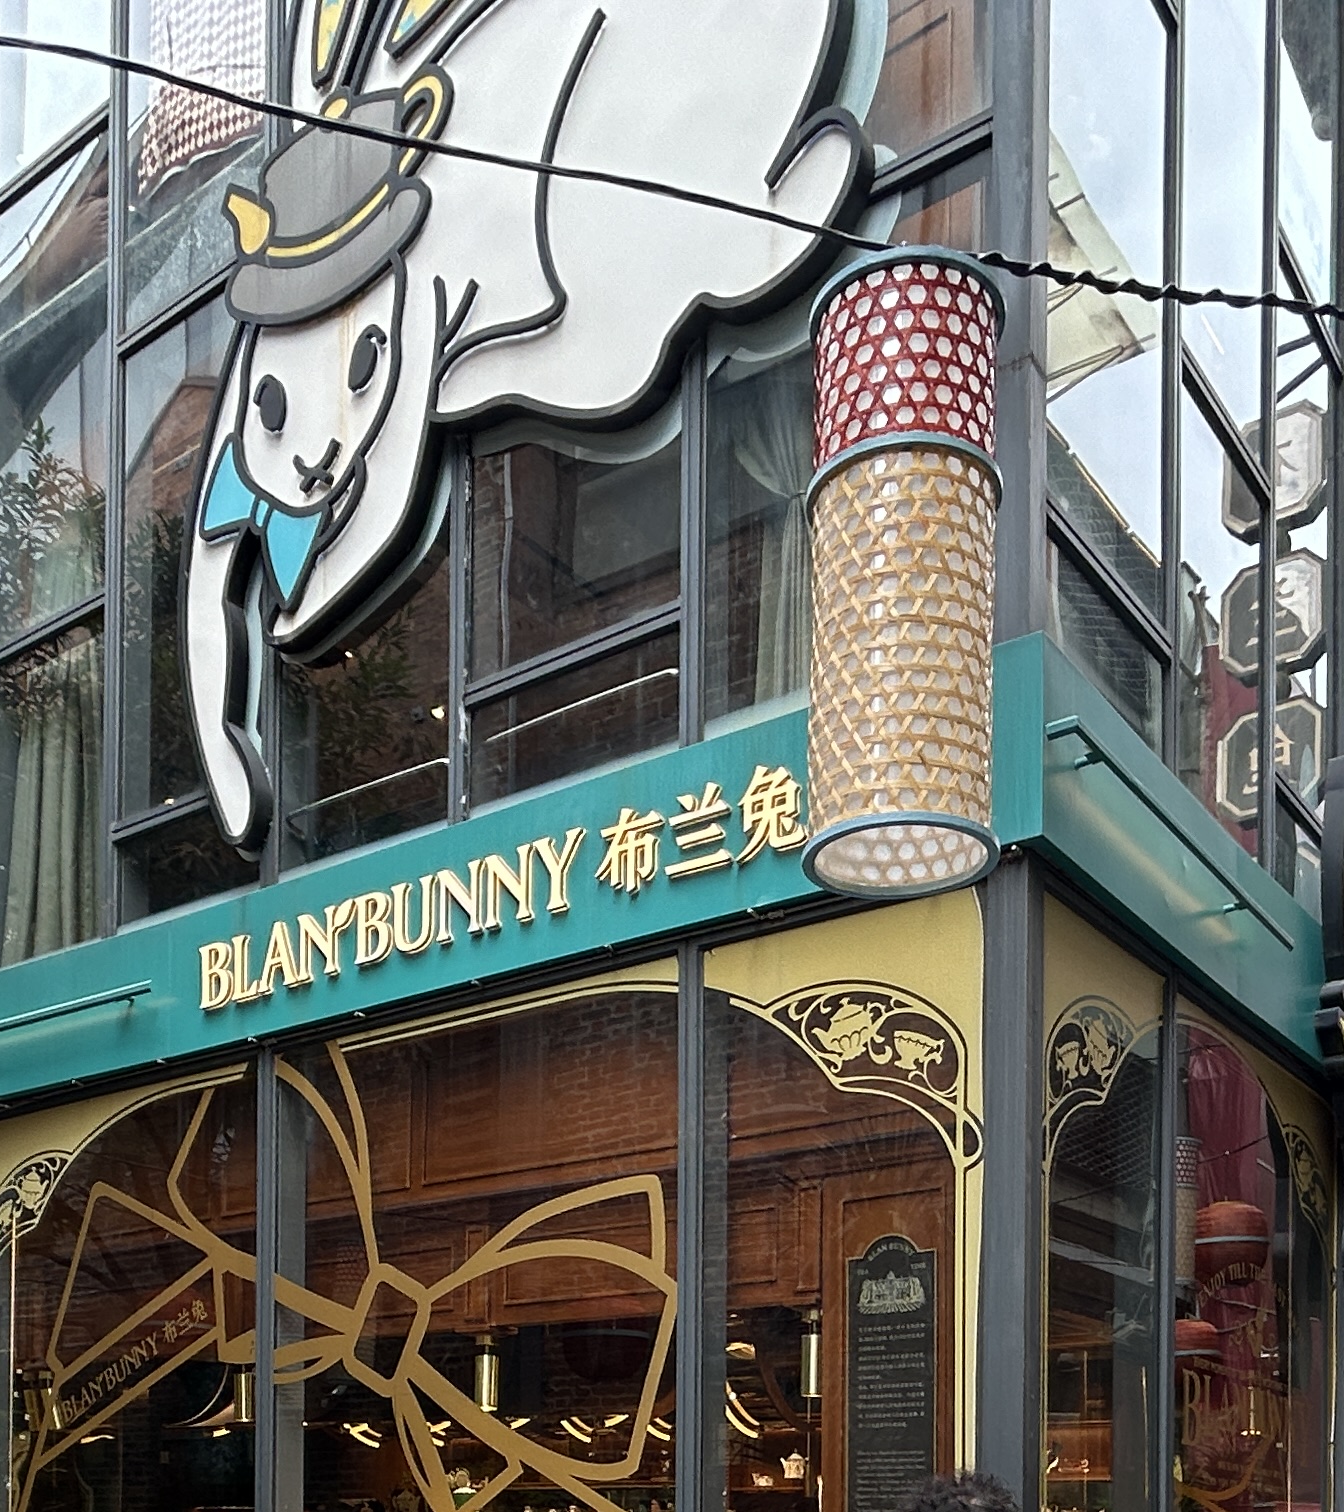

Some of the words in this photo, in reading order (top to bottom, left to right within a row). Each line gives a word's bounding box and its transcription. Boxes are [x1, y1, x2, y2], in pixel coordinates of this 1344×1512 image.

[594, 765, 809, 894] 布兰兔
[162, 1299, 208, 1343] 布兰兔
